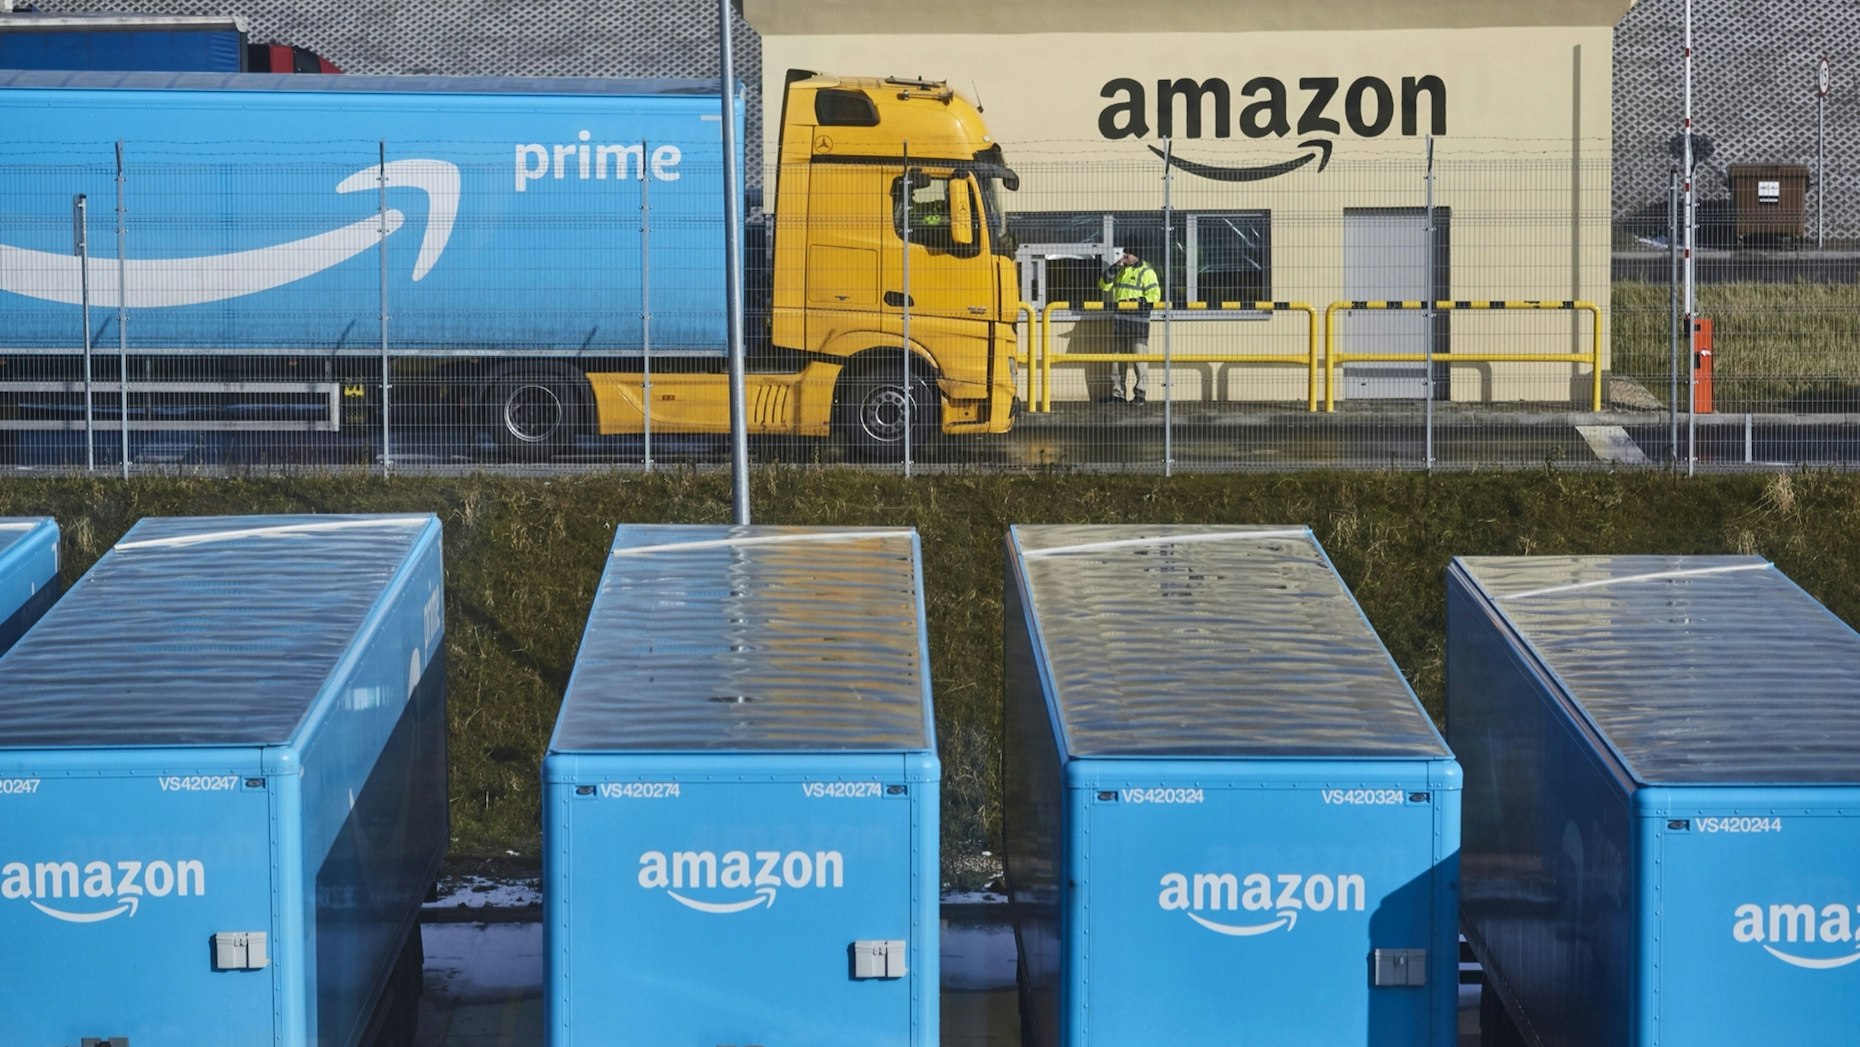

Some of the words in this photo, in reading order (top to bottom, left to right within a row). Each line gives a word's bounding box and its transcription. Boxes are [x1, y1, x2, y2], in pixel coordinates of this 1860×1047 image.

[1098, 75, 1448, 139] amazon
[515, 130, 683, 192] prime
[0, 779, 41, 794] 0247
[158, 776, 240, 792] VS420247
[600, 783, 682, 799] VS420274
[803, 783, 883, 799] VS420274
[1122, 789, 1205, 805] VS420324
[1322, 790, 1406, 806] VS420324
[1695, 818, 1783, 834] VS420244
[638, 850, 844, 889] amazon
[0, 859, 206, 898] amazon
[1159, 873, 1366, 912] amazon
[1733, 903, 1860, 943] ama
